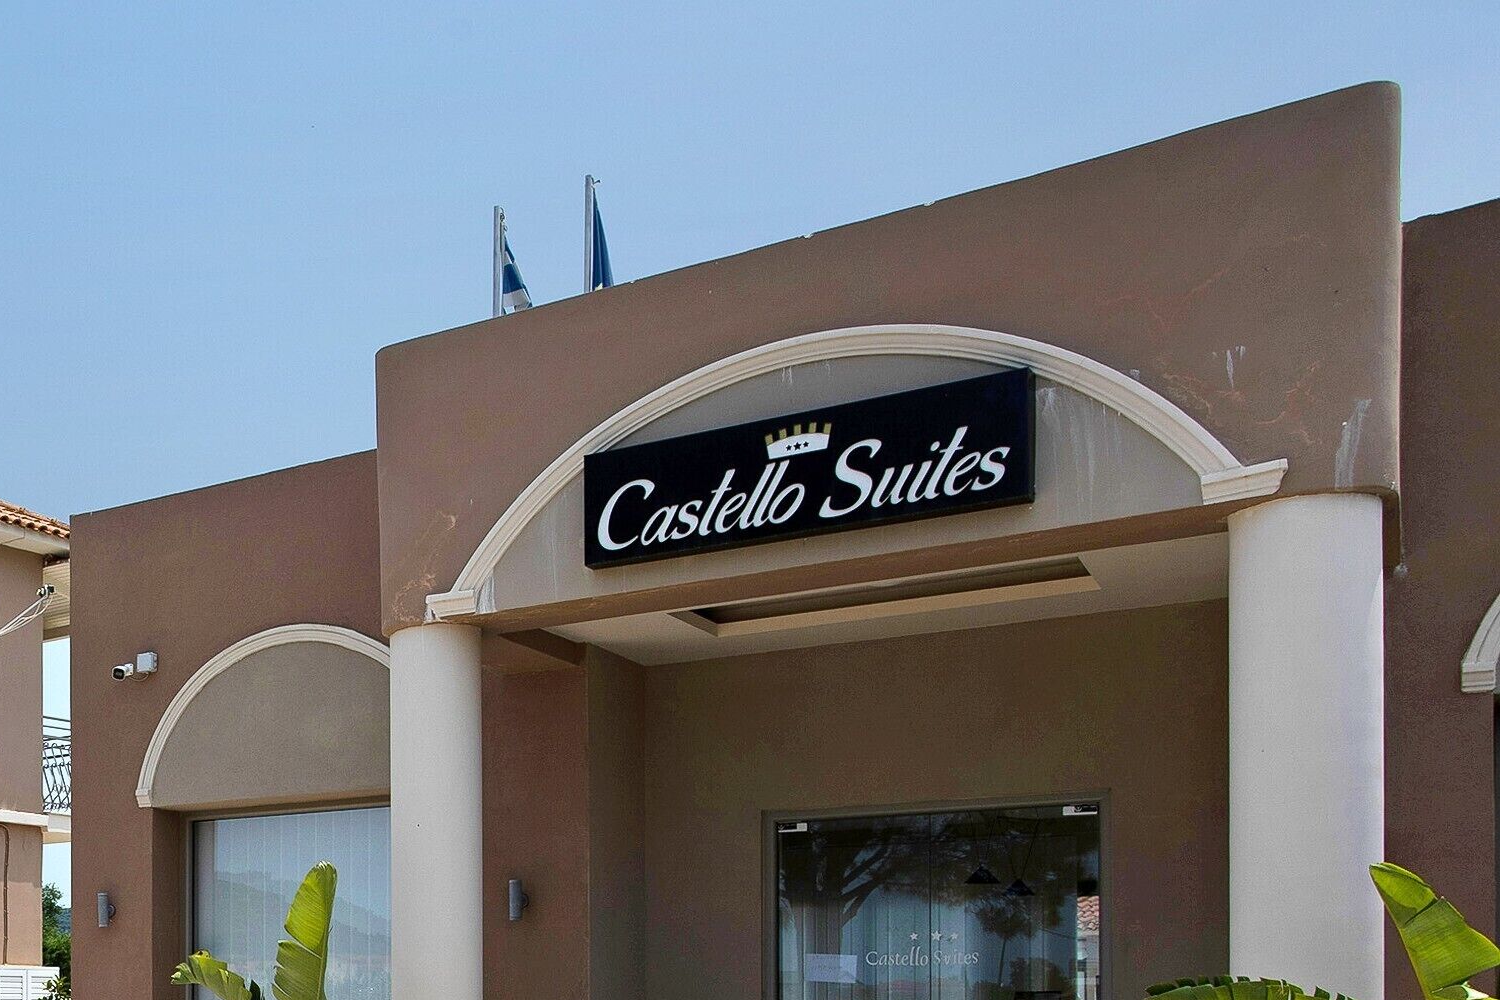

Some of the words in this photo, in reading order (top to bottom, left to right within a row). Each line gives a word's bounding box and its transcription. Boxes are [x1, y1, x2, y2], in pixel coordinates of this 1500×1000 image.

[597, 460, 805, 551] Castello
[819, 426, 1011, 518] Suites
[865, 946, 929, 966] Castello
